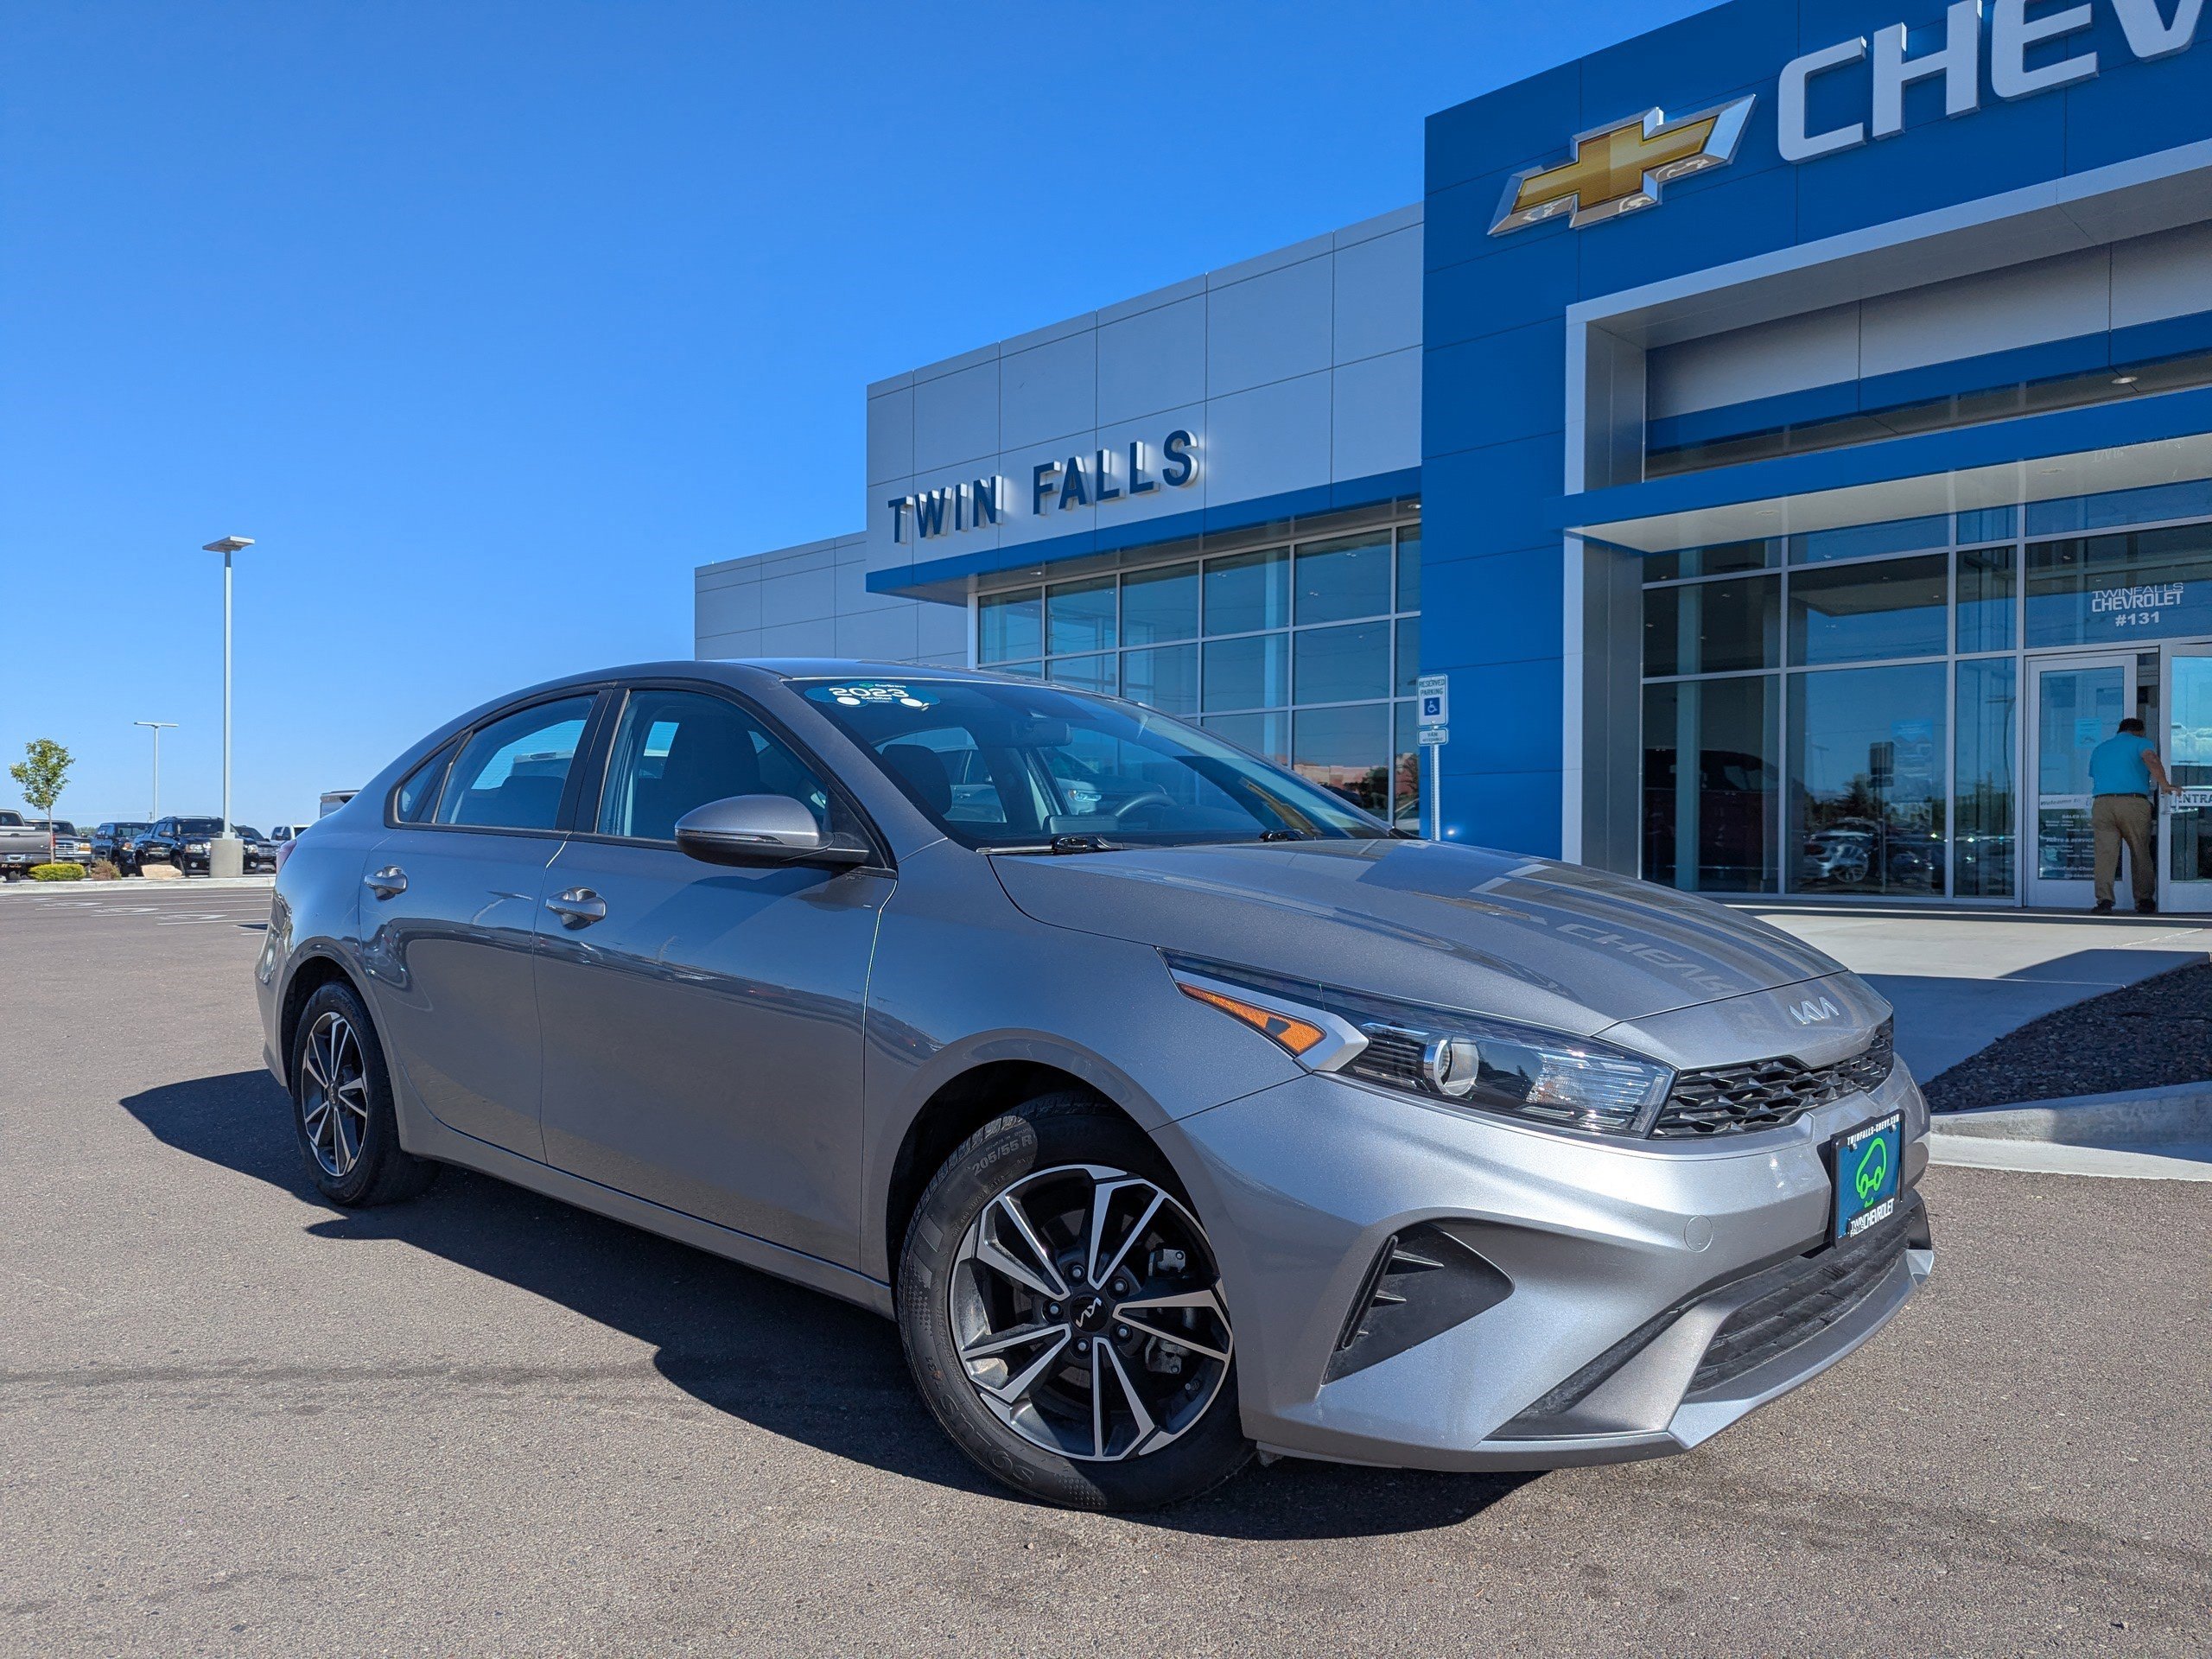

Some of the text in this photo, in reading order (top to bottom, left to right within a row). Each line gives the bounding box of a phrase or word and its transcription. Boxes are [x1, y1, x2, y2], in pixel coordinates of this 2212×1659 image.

[888, 429, 1198, 544] TWIN FALLS
[2092, 591, 2183, 613] CHEVROLET
[2115, 611, 2159, 626] #131
[829, 688, 909, 698] 2023
[1419, 679, 1445, 688] RESERVED
[1420, 688, 1444, 696] PARKING
[2178, 794, 2212, 804] NTRA
[1788, 996, 1840, 1025] KIA
[972, 1139, 1020, 1177] 205/55
[1862, 1198, 1894, 1230] CHEVROLET
[1075, 1297, 1102, 1328] KIA
